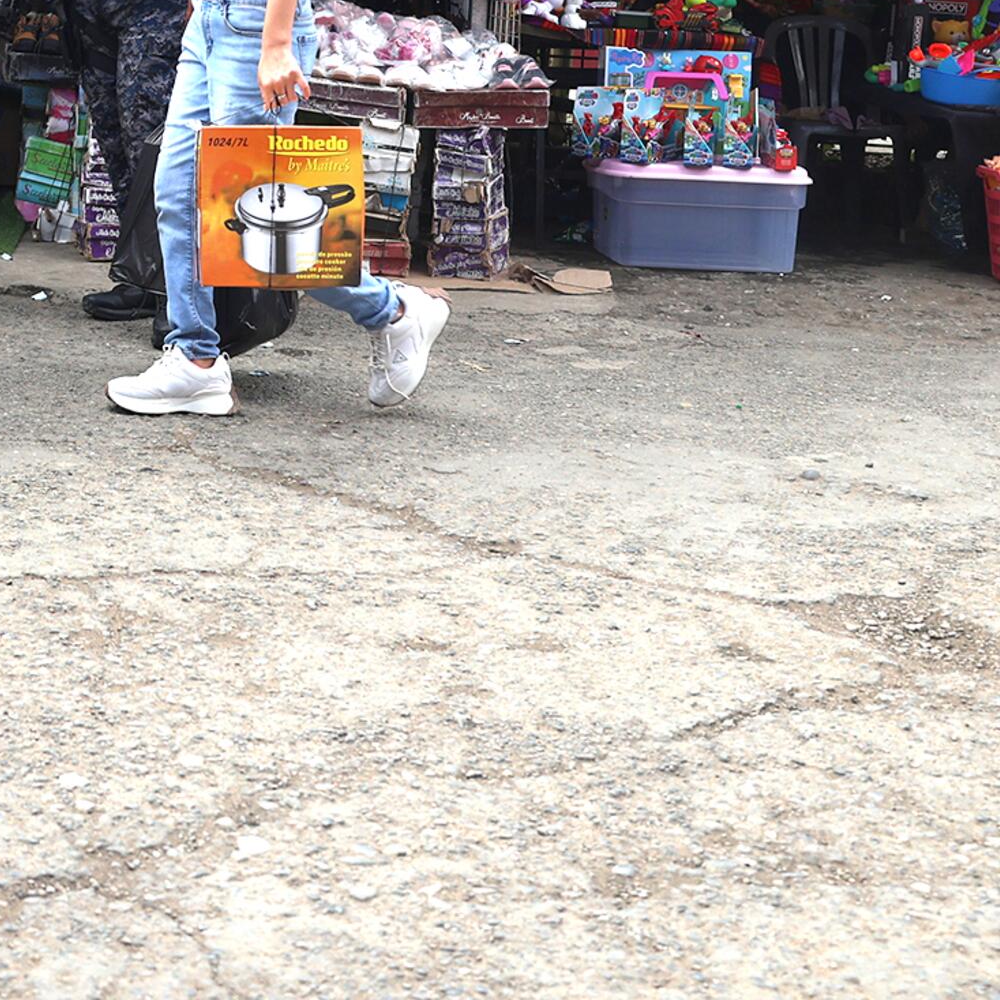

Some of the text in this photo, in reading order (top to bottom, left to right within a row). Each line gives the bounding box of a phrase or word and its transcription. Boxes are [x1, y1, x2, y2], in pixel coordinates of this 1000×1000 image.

[928, 2, 966, 13] NOPOLY
[208, 137, 249, 148] 1024/7L
[267, 135, 349, 151] Rochedo
[288, 157, 302, 175] by
